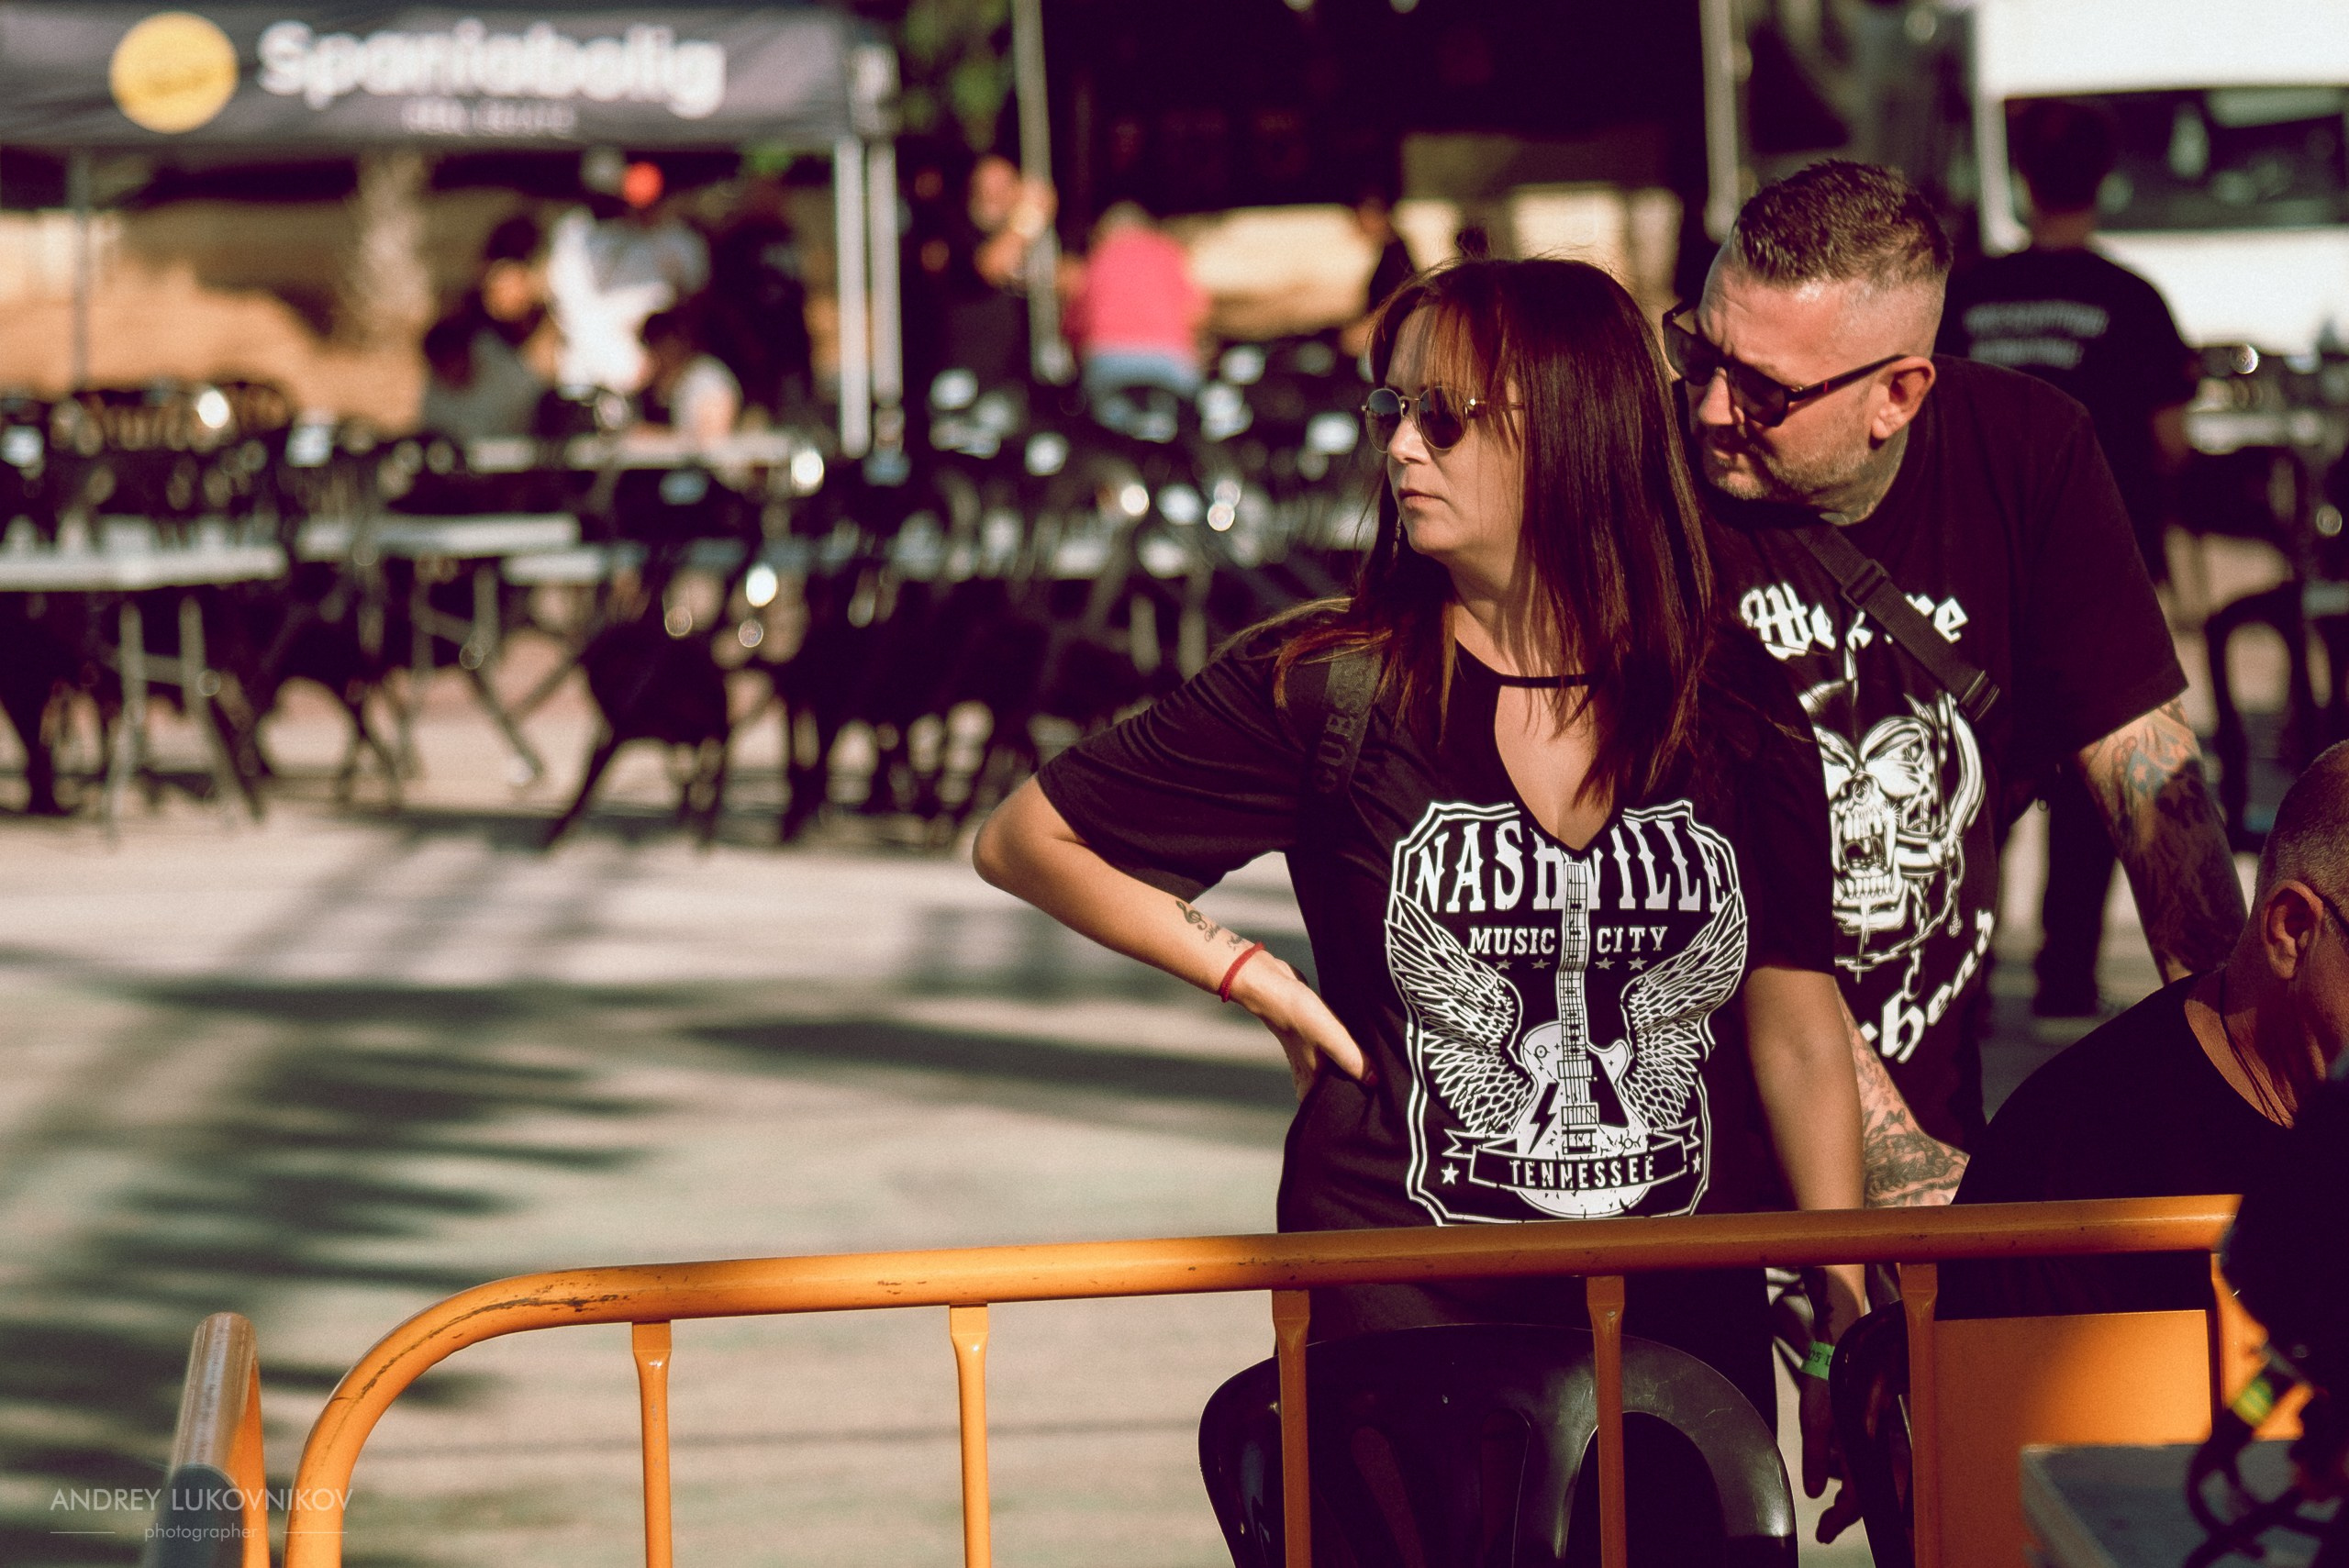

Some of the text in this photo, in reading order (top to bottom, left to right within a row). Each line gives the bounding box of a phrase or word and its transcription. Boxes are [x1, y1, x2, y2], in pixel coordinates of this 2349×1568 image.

[1469, 925, 1668, 956] MUSIC CITY
[1508, 1154, 1655, 1189] TENNESSEE
